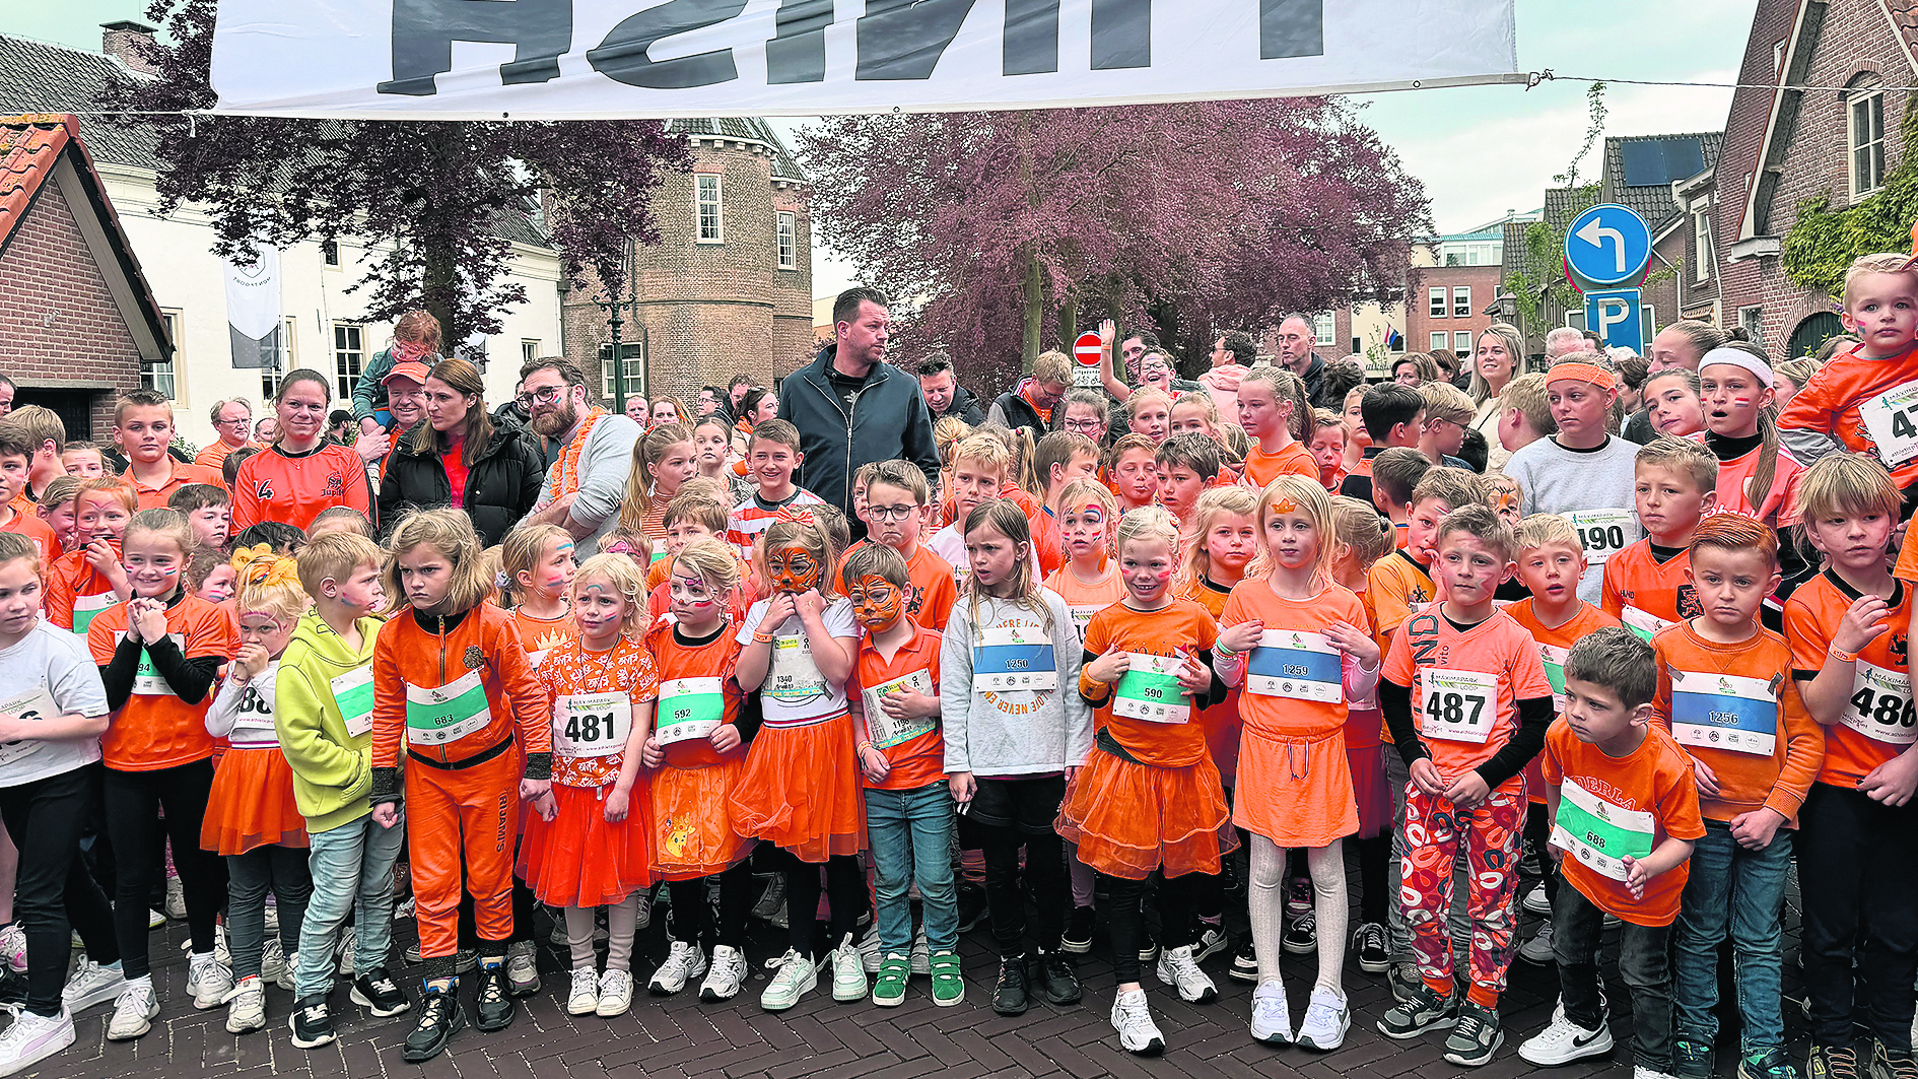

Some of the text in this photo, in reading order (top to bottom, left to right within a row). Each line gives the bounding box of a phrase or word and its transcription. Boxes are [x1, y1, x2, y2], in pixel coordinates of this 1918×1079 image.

[1598, 297, 1630, 340] P
[137, 664, 150, 672] 94
[1006, 659, 1028, 668] 1250
[1284, 664, 1308, 676] 1259
[1144, 687, 1163, 699] 590
[1, 699, 21, 710] APARK
[1427, 691, 1485, 725] 487
[1850, 686, 1918, 728] 486
[434, 713, 454, 726] 683
[674, 708, 691, 719] 592
[1709, 709, 1739, 725] 1256
[564, 712, 615, 742] 481
[1586, 831, 1606, 849] 688
